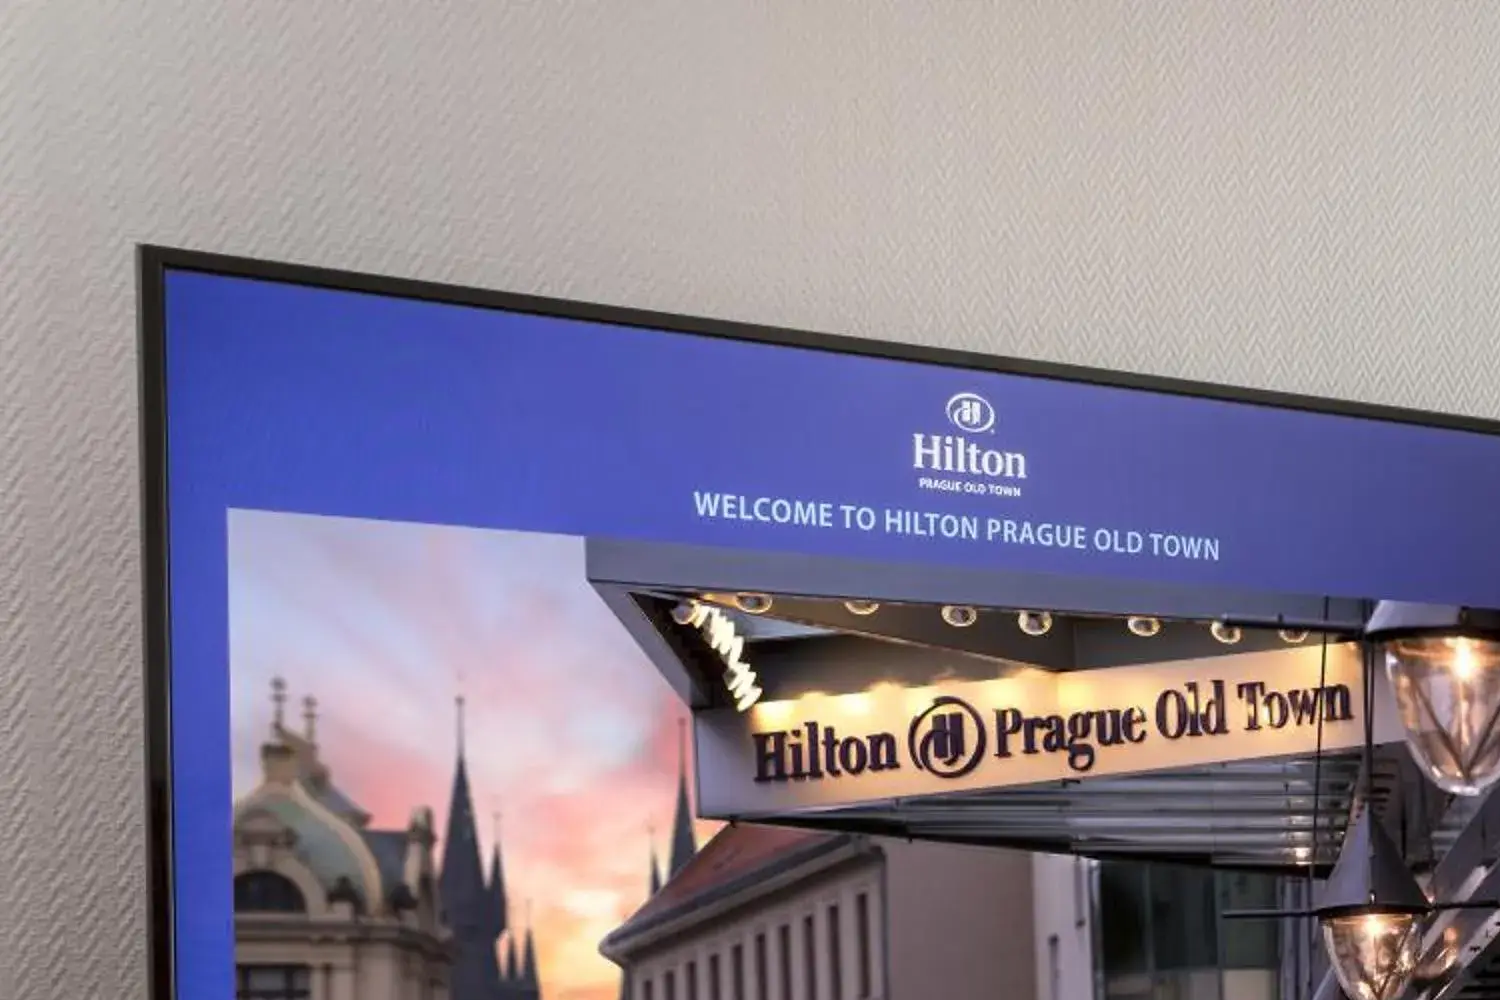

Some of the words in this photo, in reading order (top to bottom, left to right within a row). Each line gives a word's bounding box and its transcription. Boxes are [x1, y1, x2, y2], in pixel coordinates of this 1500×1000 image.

[913, 433, 1027, 479] Hilton
[919, 477, 962, 493] PRAGUE
[963, 483, 987, 495] OLD
[988, 485, 1021, 497] TOWN
[694, 491, 833, 527] WELCOME
[839, 505, 875, 531] TO
[884, 508, 978, 541] HILTON
[986, 518, 1087, 549] PRAGUE
[1093, 528, 1143, 554] OLD
[1148, 532, 1220, 561] TOWN
[752, 721, 899, 784] Hilton
[993, 707, 1147, 771] Prague
[1155, 681, 1228, 740] Old
[1236, 676, 1354, 731] Town
